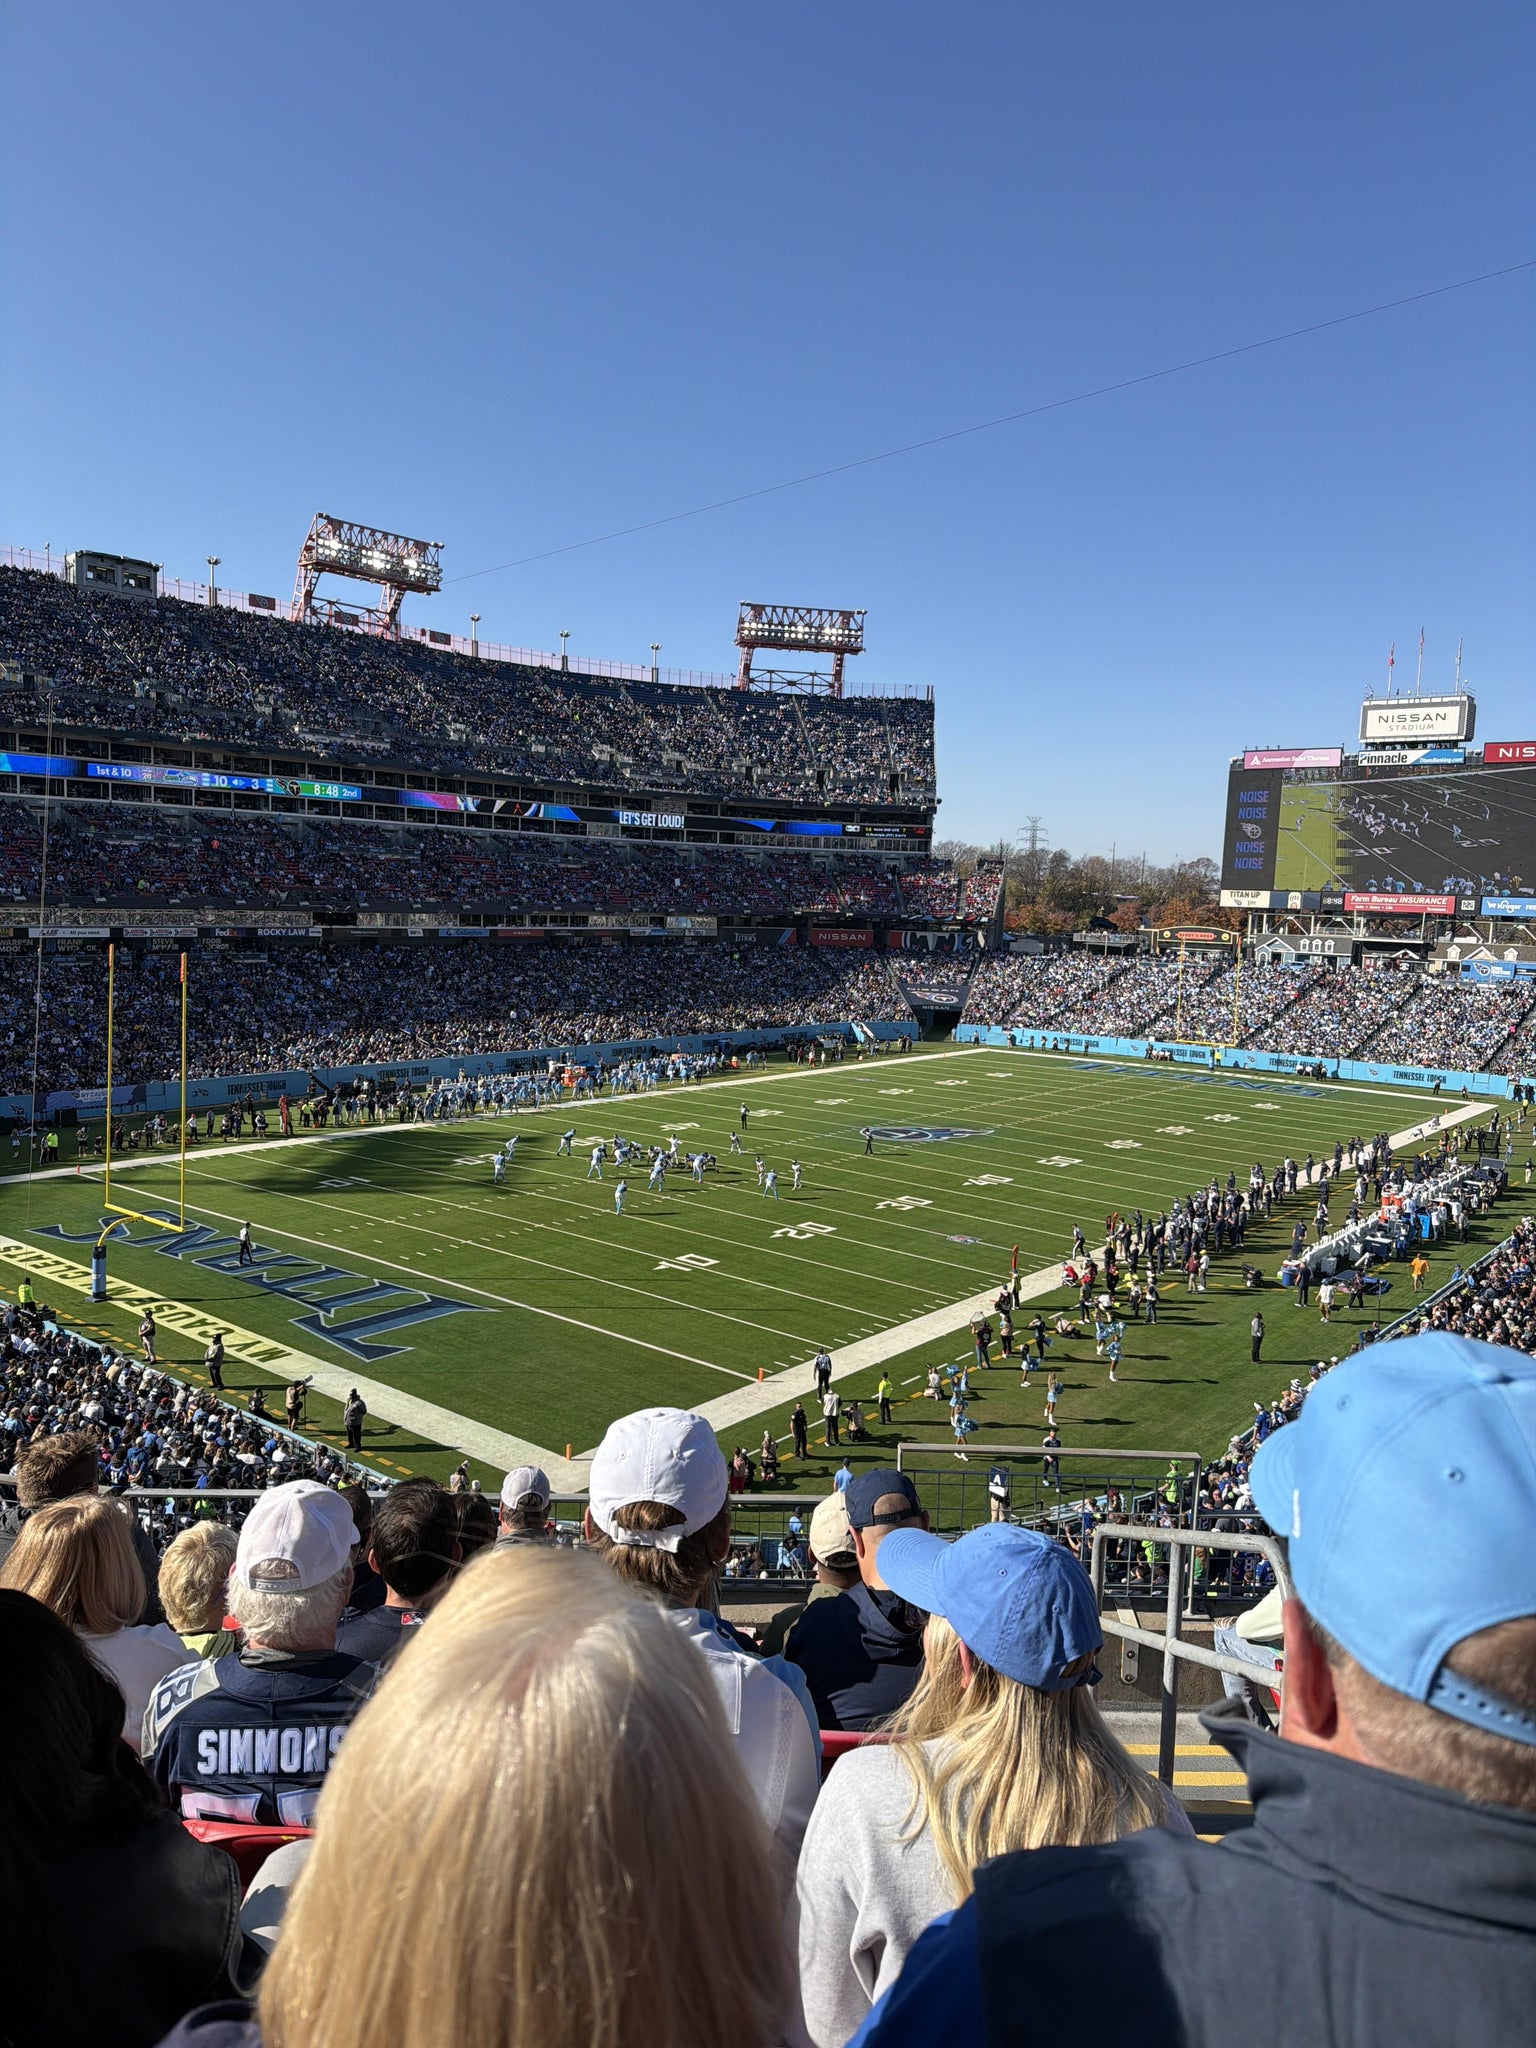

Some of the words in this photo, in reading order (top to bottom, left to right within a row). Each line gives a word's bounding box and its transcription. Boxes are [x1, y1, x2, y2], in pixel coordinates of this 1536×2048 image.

[1378, 712, 1446, 724] NISSAN
[1388, 723, 1434, 732] STADIUM
[1499, 746, 1536, 758] NIS
[1359, 752, 1408, 765] Pinnacle
[96, 765, 110, 775] 1st
[111, 767, 119, 776] &
[120, 768, 131, 777] 10
[214, 775, 227, 787] 10
[251, 778, 259, 790] 3
[313, 784, 339, 797] 8:48
[342, 788, 358, 797] 2nd
[1239, 790, 1269, 802] NOISE
[1238, 807, 1268, 819] NOISE
[619, 811, 640, 825] LET'S
[641, 813, 657, 827] GET
[657, 814, 685, 829] LOUD!
[1235, 841, 1265, 853] NOISE
[1234, 857, 1263, 869] NOISE
[1250, 891, 1261, 899] UP
[1351, 895, 1370, 903] Farm
[1371, 895, 1398, 904] Bureau
[1399, 896, 1448, 905] INSURANCE
[1497, 900, 1522, 913] Kroger
[215, 928, 238, 937] FedEx
[257, 928, 287, 936] ROCKY
[287, 928, 306, 936] LAW
[819, 933, 866, 941] NISSAN
[411, 1065, 429, 1078] TOUGH
[1393, 1070, 1425, 1082] TENNESSEE
[227, 1081, 265, 1095] TENNESSEE
[1036, 1155, 1084, 1168] 50
[966, 1173, 1015, 1186] 40
[877, 1195, 934, 1212] 30
[772, 1221, 838, 1240] 20
[1, 1244, 93, 1281] CLEATS
[660, 1252, 721, 1272] 10
[25, 1208, 503, 1363] TITANS
[226, 1340, 293, 1364] MY
[197, 1726, 349, 1776] SIMMONS
